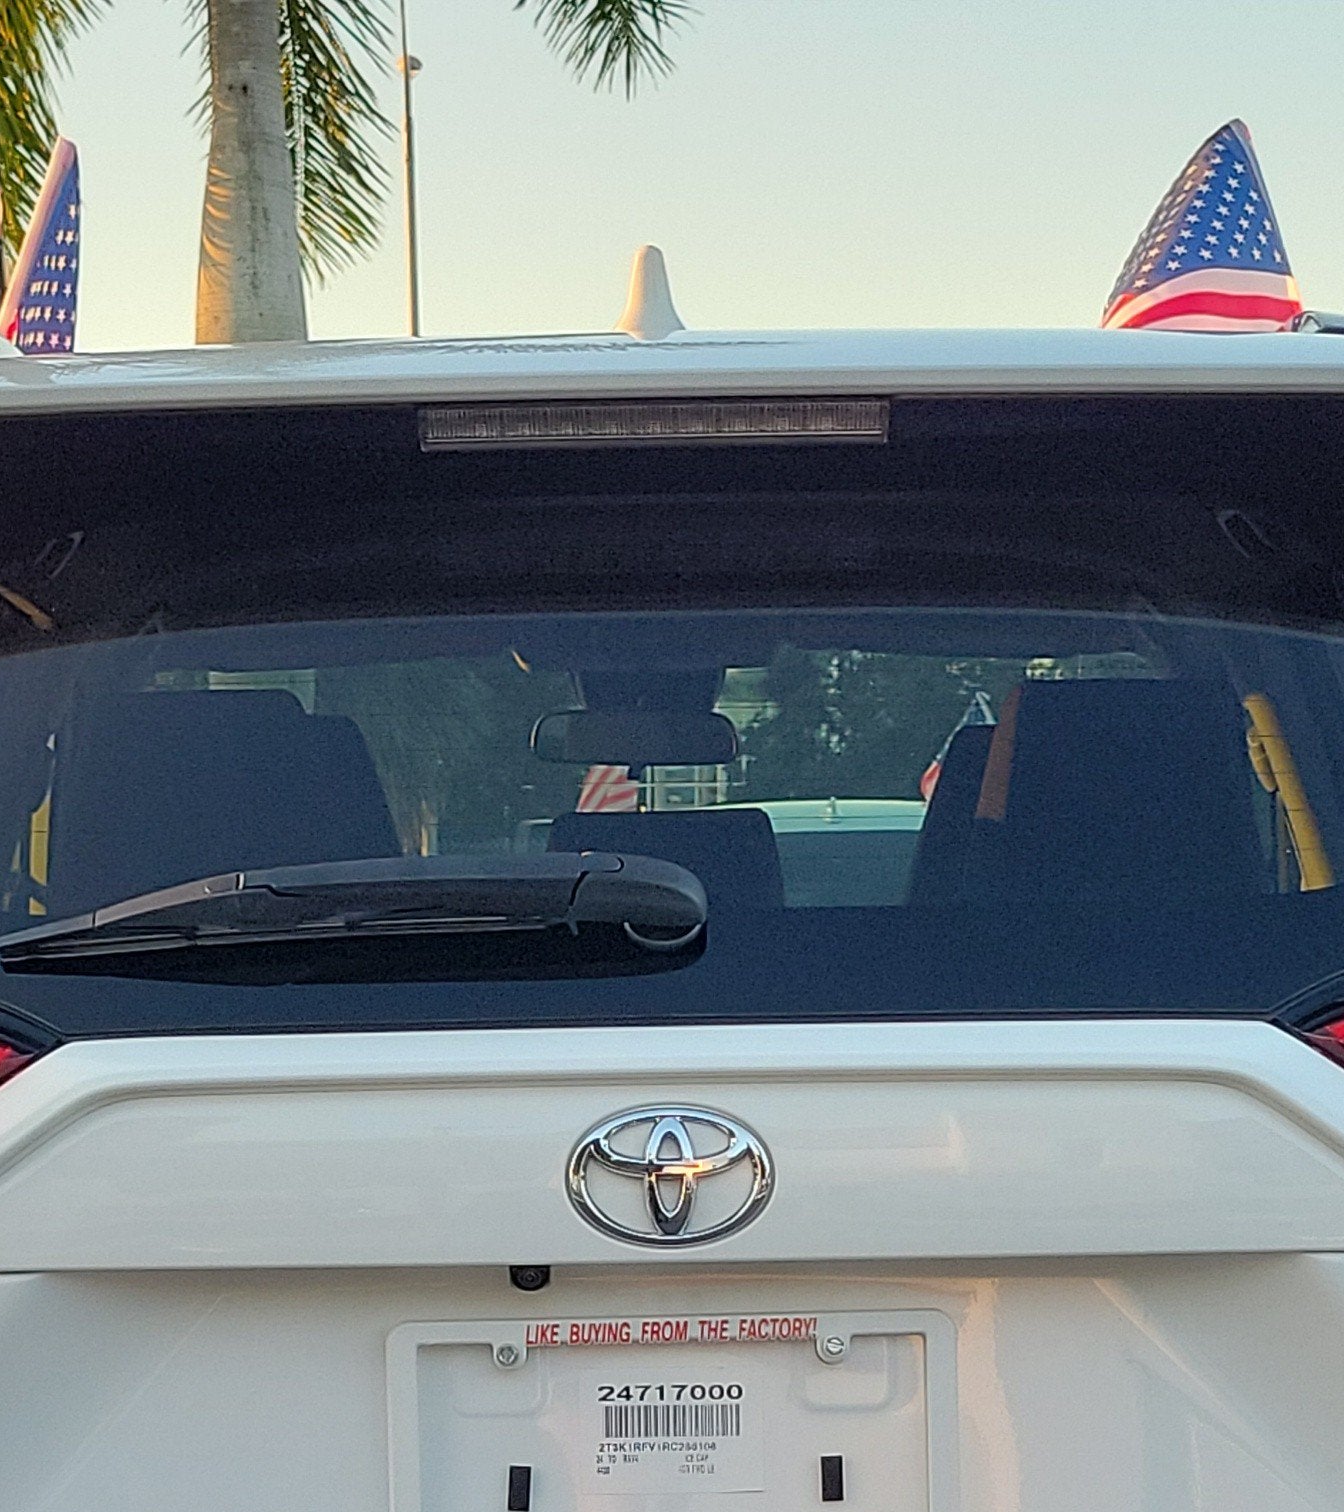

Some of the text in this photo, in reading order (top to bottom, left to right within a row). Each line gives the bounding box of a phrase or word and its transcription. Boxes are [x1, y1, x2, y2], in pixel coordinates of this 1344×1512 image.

[525, 1316, 818, 1345] LIKE BUYING FROM THE FACTORY!
[597, 1384, 743, 1401] 24717000
